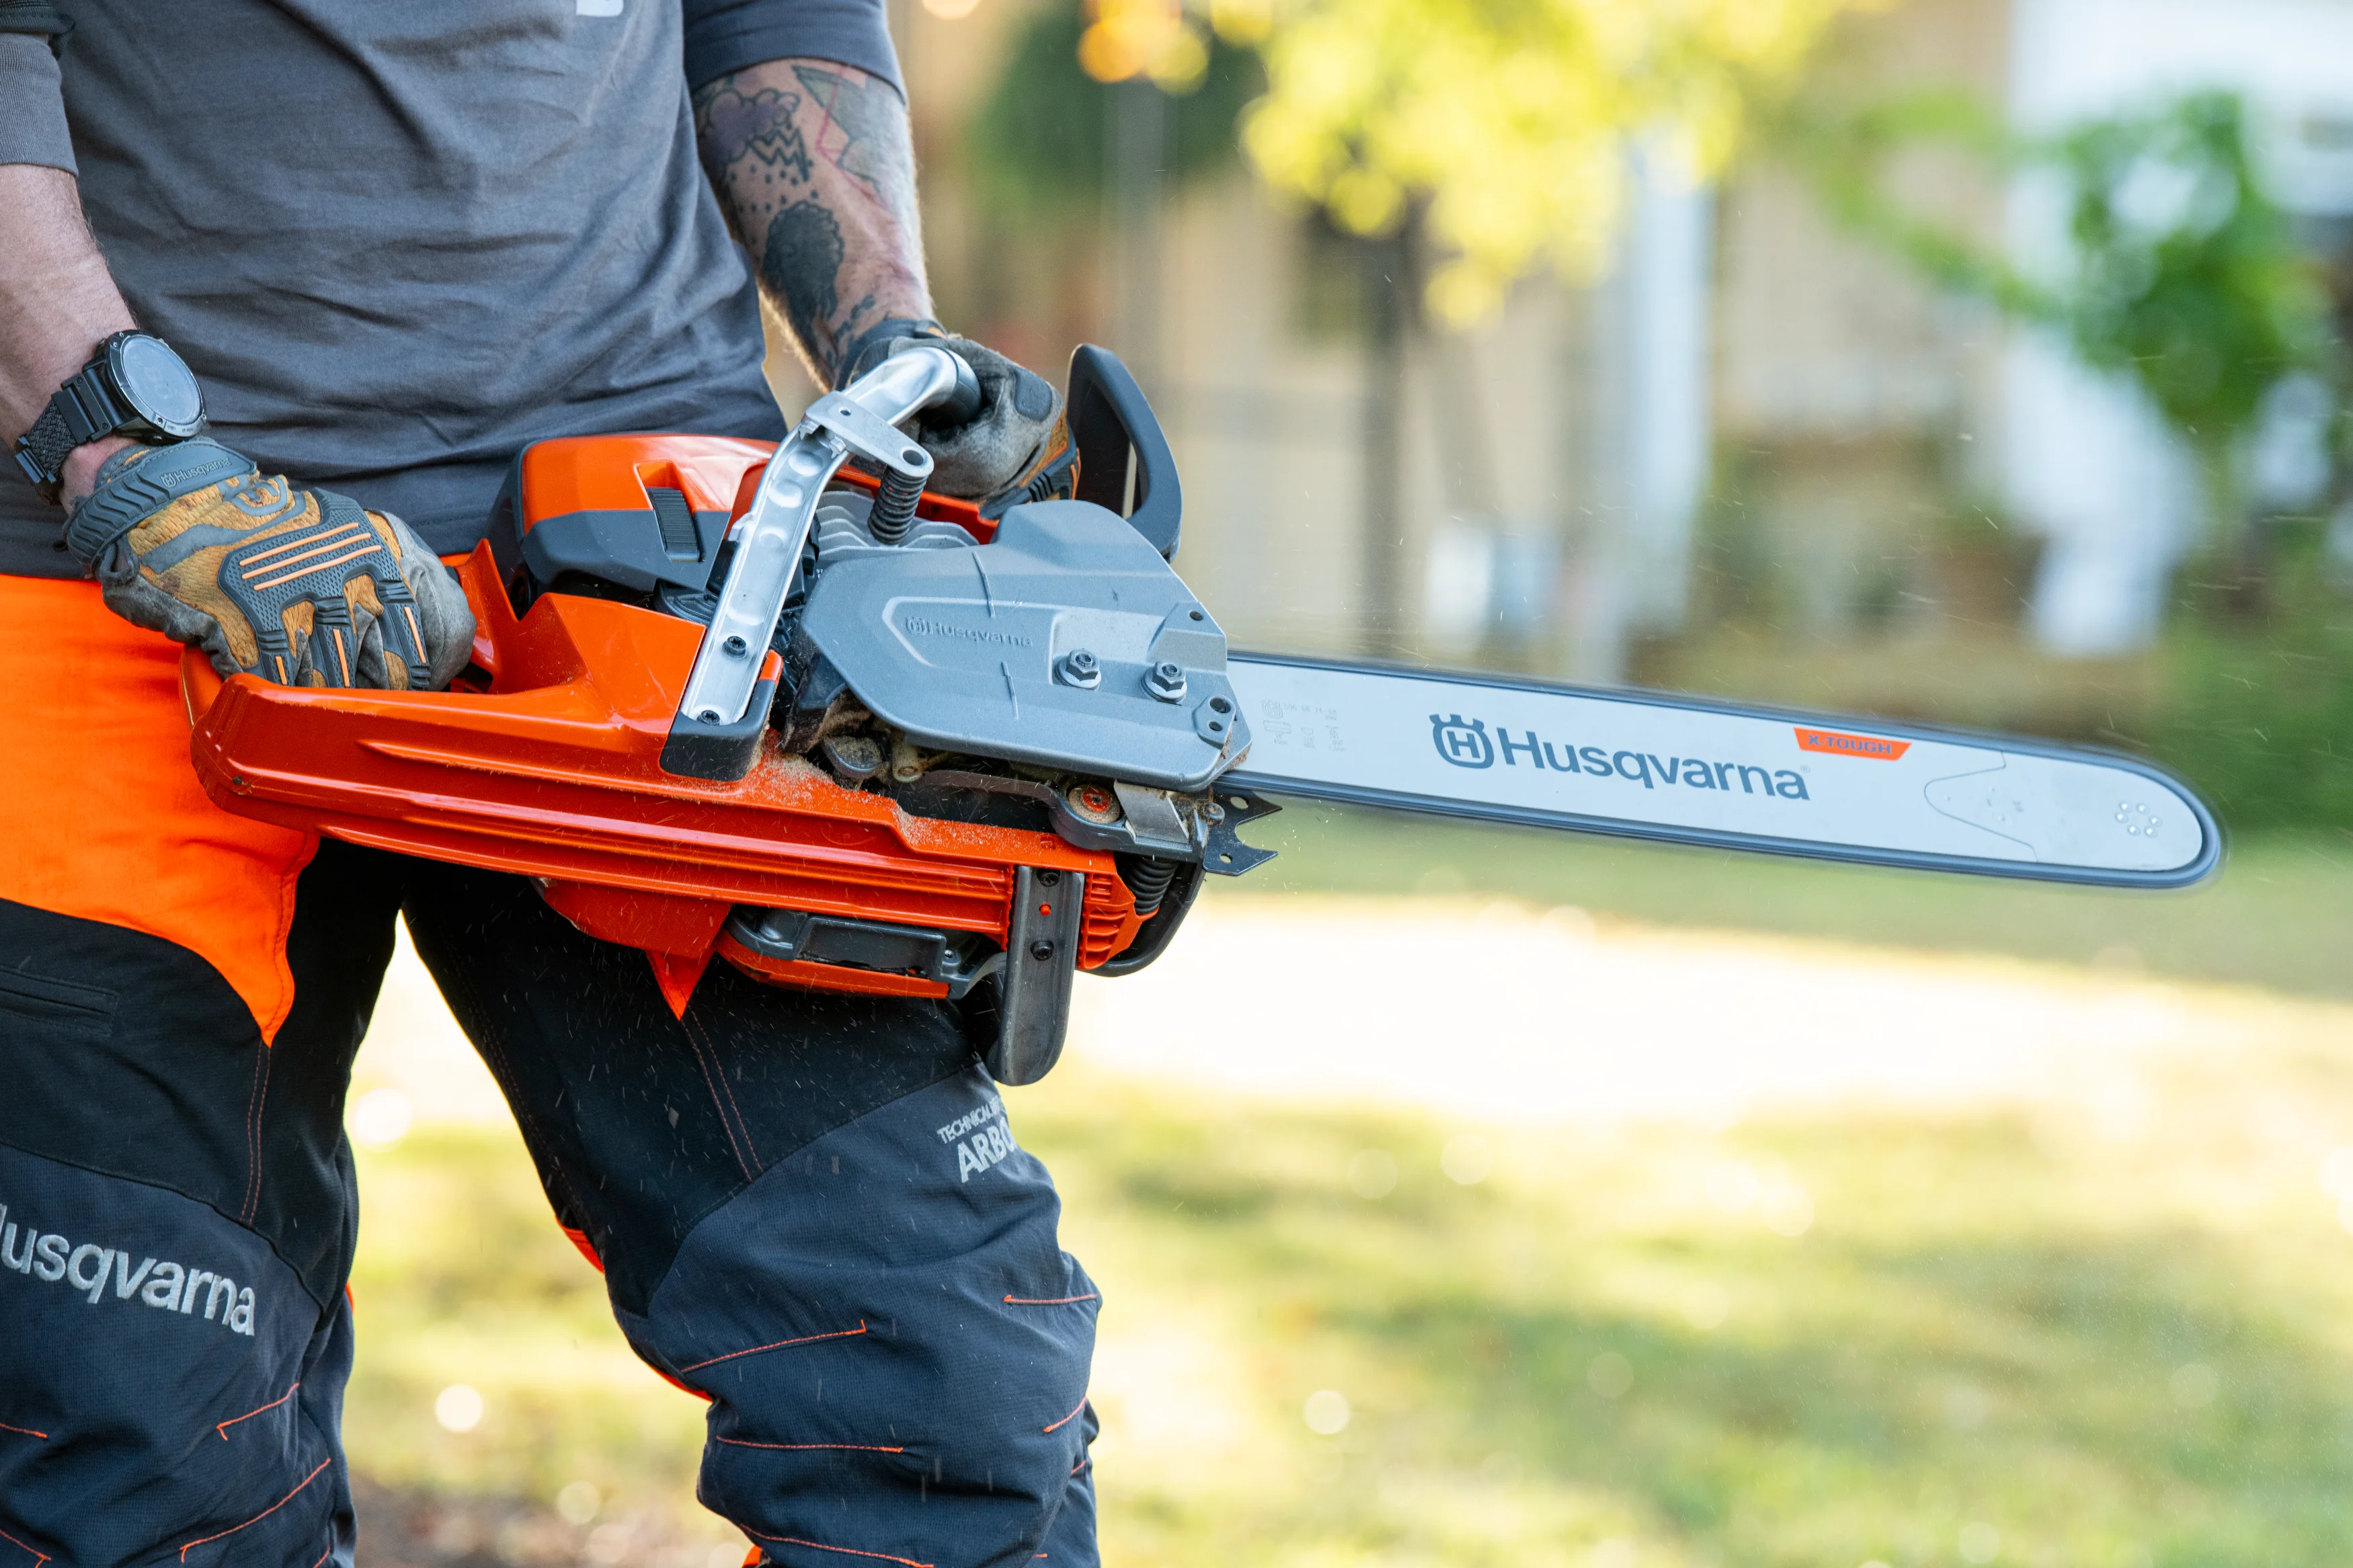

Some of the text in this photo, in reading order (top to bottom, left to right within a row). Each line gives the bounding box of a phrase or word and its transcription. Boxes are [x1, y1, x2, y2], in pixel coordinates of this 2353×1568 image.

[174, 457, 232, 483] Husqvarna
[926, 620, 1033, 649] Husqvarna
[1807, 733, 1892, 754] X-TOUGH
[1496, 727, 1810, 800] Husqvarna
[936, 1103, 994, 1145] TECHNICAL
[957, 1116, 1019, 1184] ARBO
